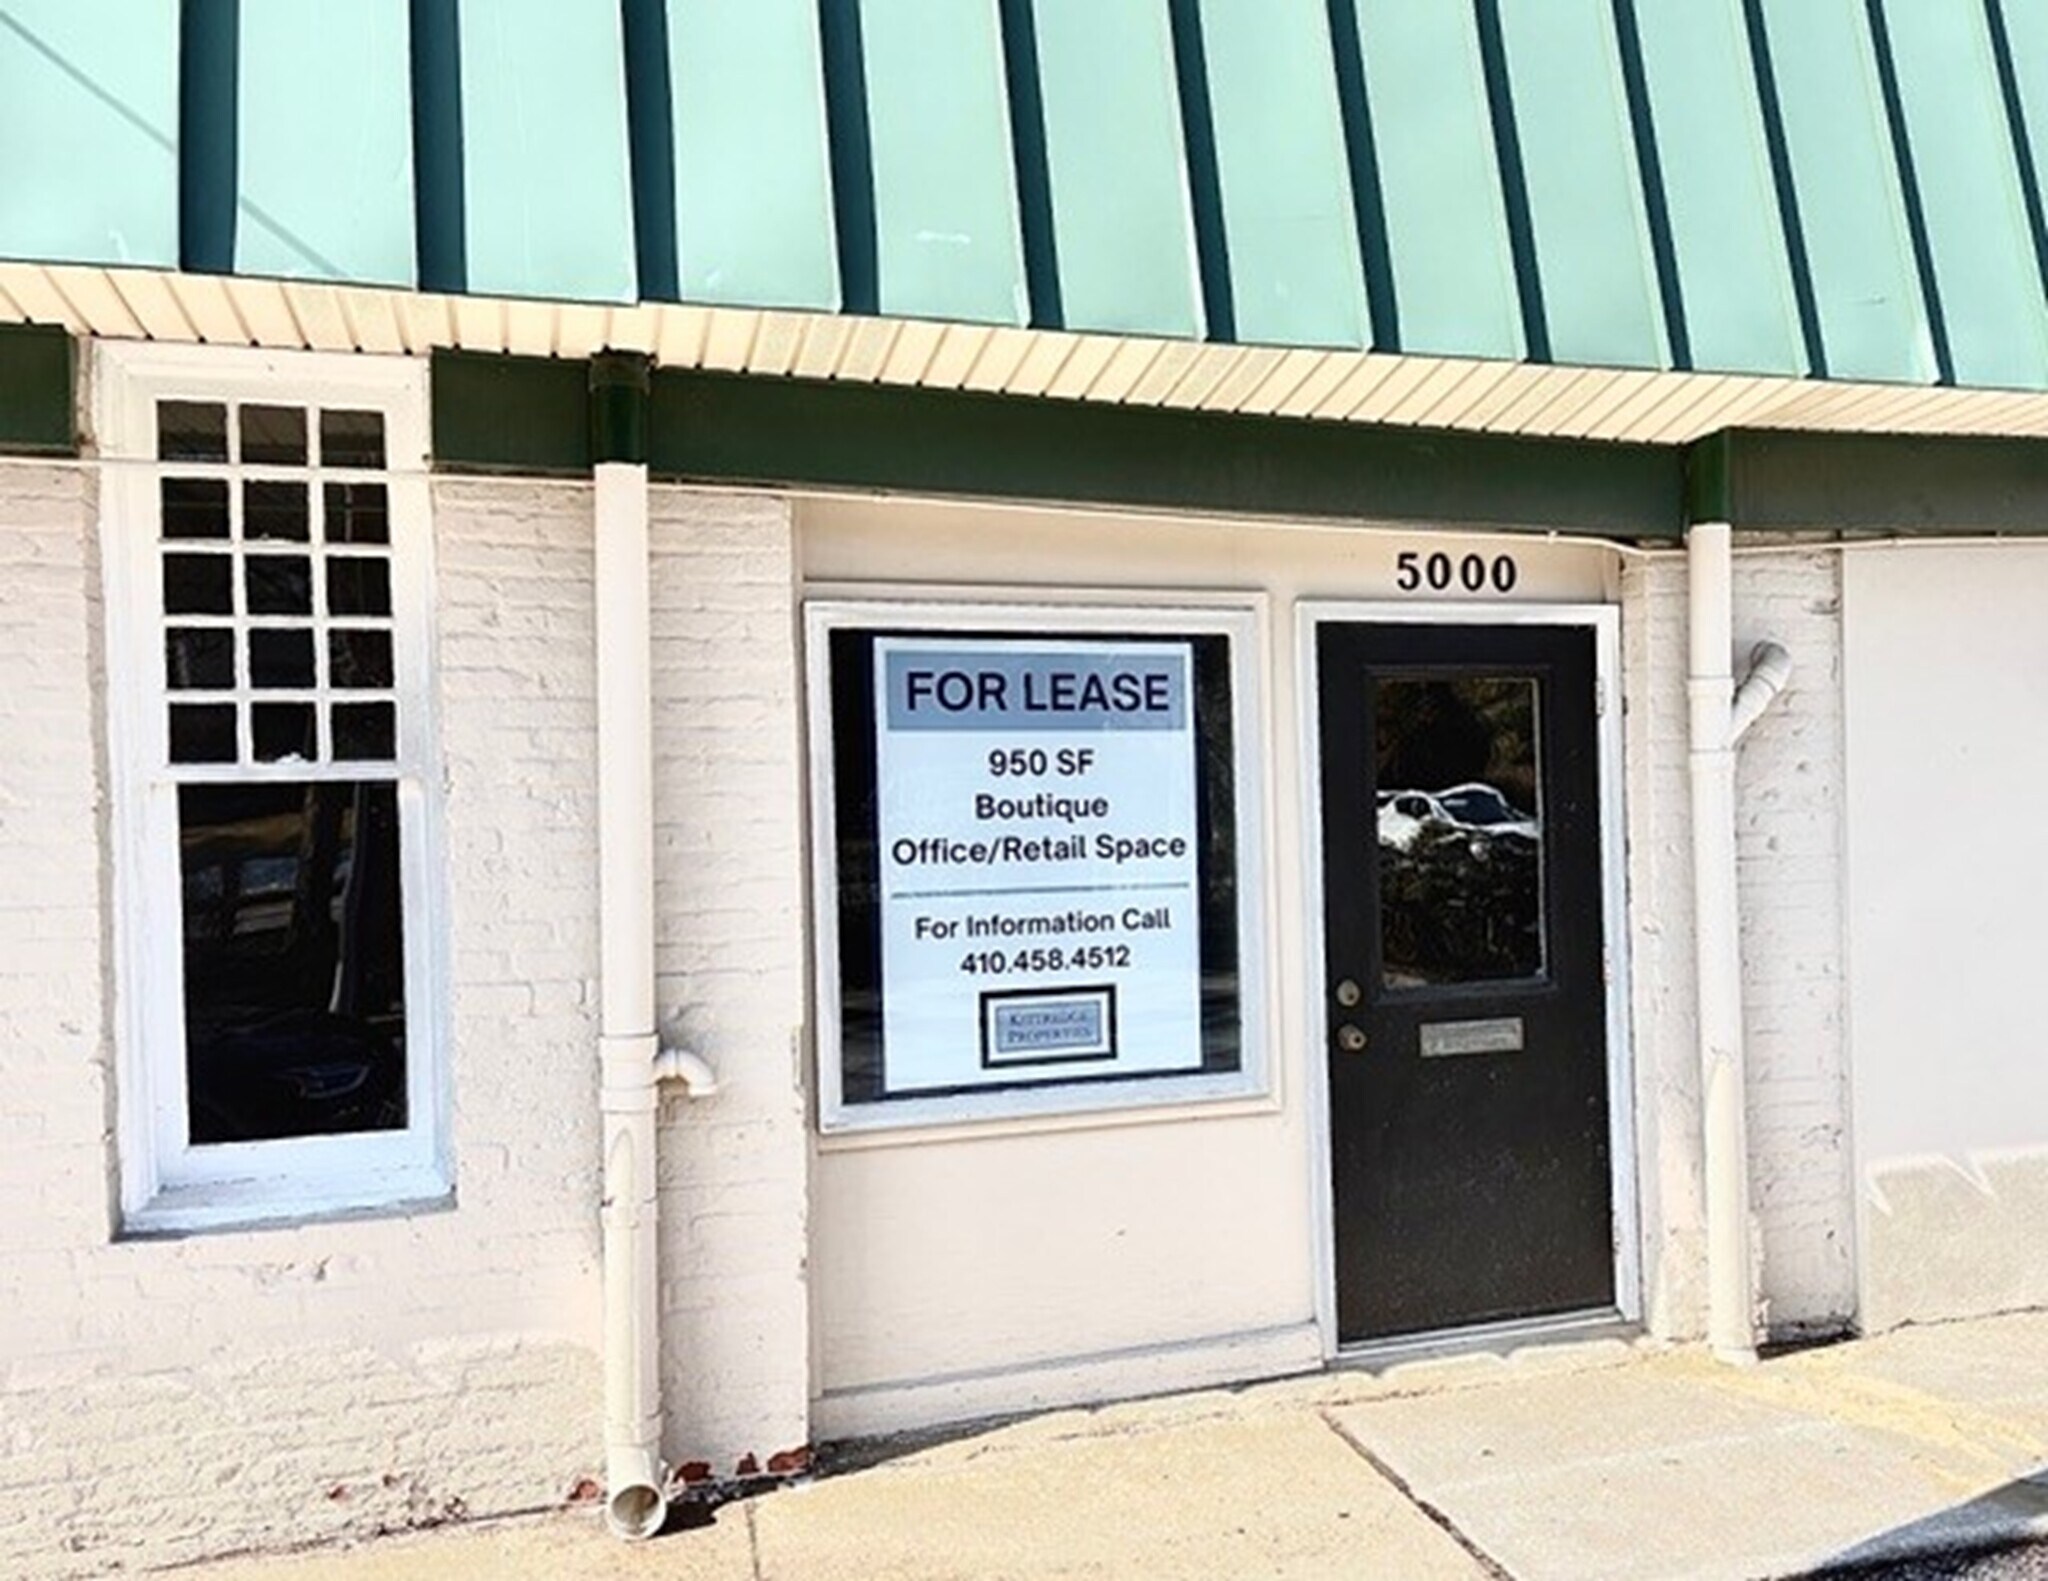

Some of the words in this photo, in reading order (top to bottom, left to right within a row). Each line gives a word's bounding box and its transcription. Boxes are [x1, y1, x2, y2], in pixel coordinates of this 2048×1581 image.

[1397, 552, 1517, 592] 5000
[907, 671, 1008, 712] FOR
[1023, 672, 1170, 712] LEASE
[988, 748, 1048, 777] 950
[1056, 748, 1094, 776] SF
[975, 793, 1109, 824] Boutique
[891, 834, 1087, 866] Office/Retail
[1095, 833, 1187, 864] Space
[915, 916, 959, 940] For
[966, 910, 1115, 937] Information
[1121, 907, 1171, 931] Call
[960, 944, 1130, 975] 410.458.4512
